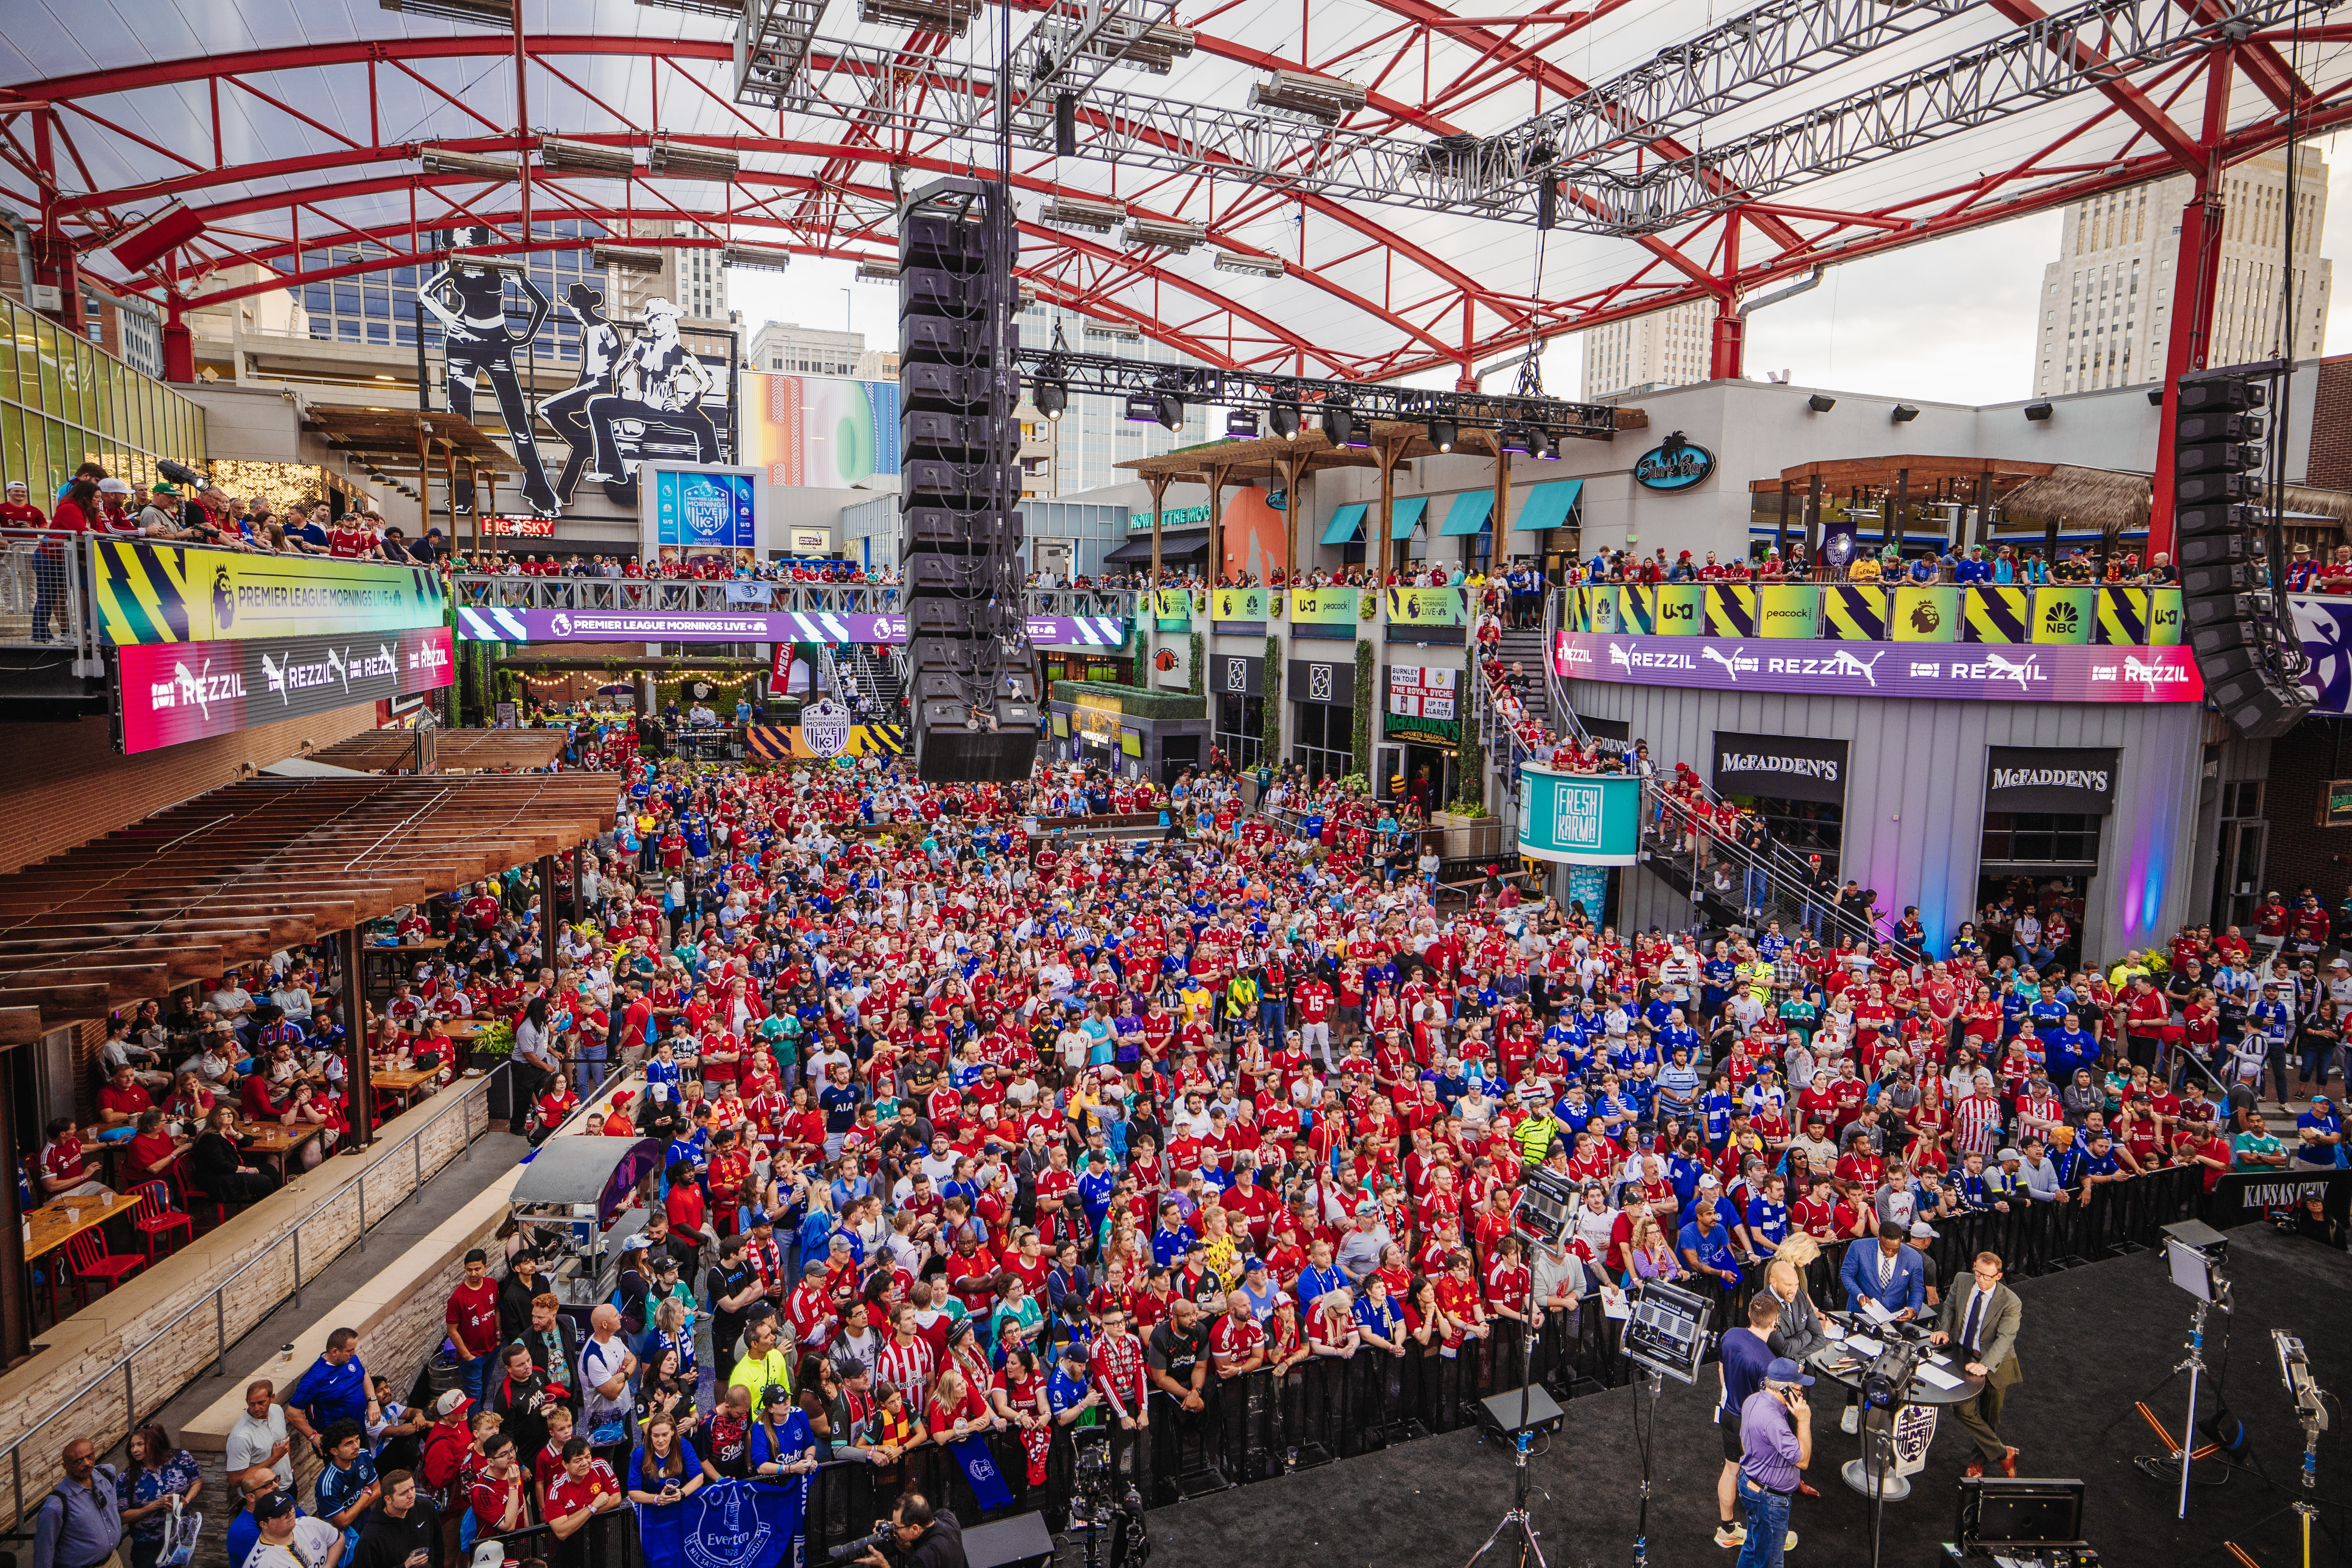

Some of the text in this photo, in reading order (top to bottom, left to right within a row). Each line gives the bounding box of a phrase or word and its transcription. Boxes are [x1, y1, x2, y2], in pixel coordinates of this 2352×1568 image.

[1638, 454, 1704, 480] Shark Bar
[1131, 513, 1154, 529] HOWL
[1169, 508, 1187, 524] THE
[1188, 505, 1211, 522] MOO
[523, 521, 552, 534] SKY
[238, 586, 388, 607] PREMIER LEAGUE MORNINGS LIVE
[1323, 601, 1347, 613] peacock
[1766, 609, 1808, 620] peacock
[574, 620, 746, 631] PREMIER LEAGUE MORNINGS LIVE
[1597, 615, 1610, 624] NBC
[2046, 623, 2077, 633] NBC
[421, 649, 448, 668] REZZIL
[1564, 648, 1593, 663] REZZIL
[1632, 653, 1697, 669] REZZIL
[365, 655, 399, 677] REZZIL
[1768, 658, 1861, 675] REZZIL
[1951, 663, 2048, 680] REZZIL
[2124, 666, 2189, 682] REZZIL
[289, 663, 335, 689] REZZIL
[182, 673, 247, 705] REZZIL
[1392, 685, 1453, 698] THE ROYAL DYCHE
[1425, 708, 1451, 716] CLARETS
[1086, 731, 1109, 744] PENDERGAST
[1424, 732, 1446, 741] SALOON
[1722, 752, 1838, 781] McFADDEN'S
[1992, 768, 2108, 792] McFADDEN'S
[1559, 788, 1598, 816] FRESH
[1557, 814, 1596, 843] KARMA
[835, 1102, 853, 1112] AIA
[2243, 1183, 2297, 1208] KANSAS
[1895, 1206, 1909, 1216] AXA
[527, 1390, 545, 1414] AXA
[708, 1532, 749, 1546] Everton
[690, 1547, 701, 1558] NIL
